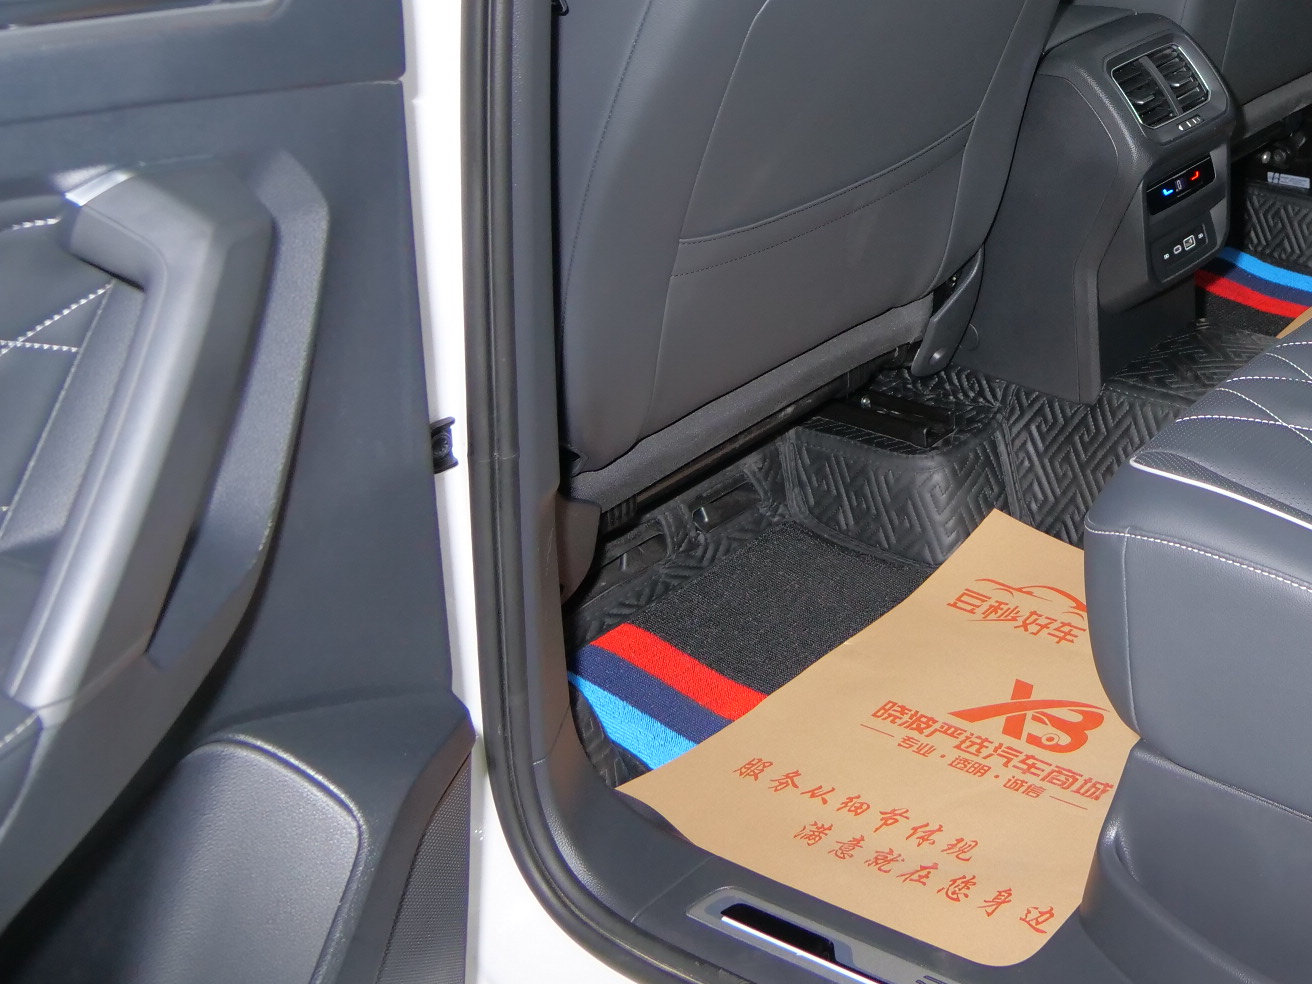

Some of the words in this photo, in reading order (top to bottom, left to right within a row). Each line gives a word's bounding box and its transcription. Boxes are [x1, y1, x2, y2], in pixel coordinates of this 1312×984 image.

[870, 700, 1115, 801] 晓波严选汽车商城
[733, 757, 979, 862] 服务从细节体现
[793, 820, 1056, 934] 满意就在您身边
